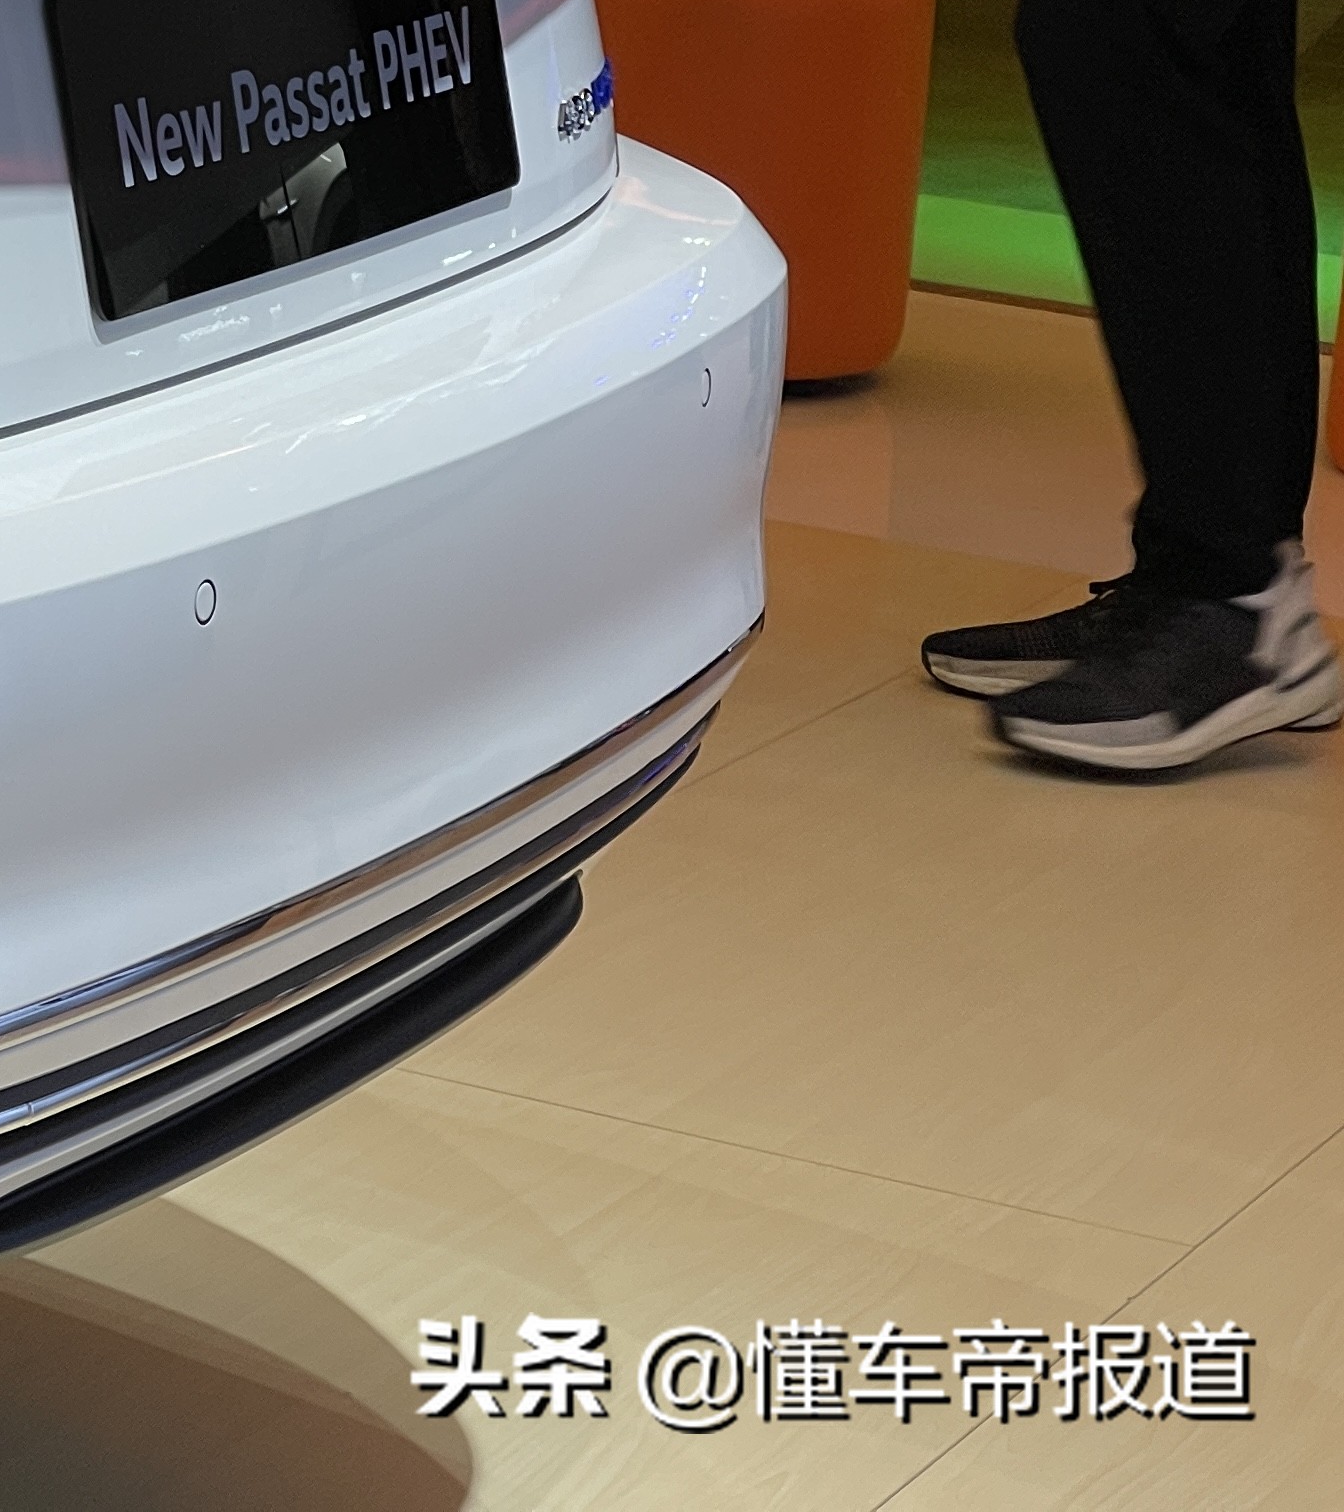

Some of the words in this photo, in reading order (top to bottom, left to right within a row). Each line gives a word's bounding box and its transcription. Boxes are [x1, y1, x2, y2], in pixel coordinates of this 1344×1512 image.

[114, 94, 223, 188] New
[231, 52, 372, 156] Passat
[374, 5, 474, 112] PHEV
